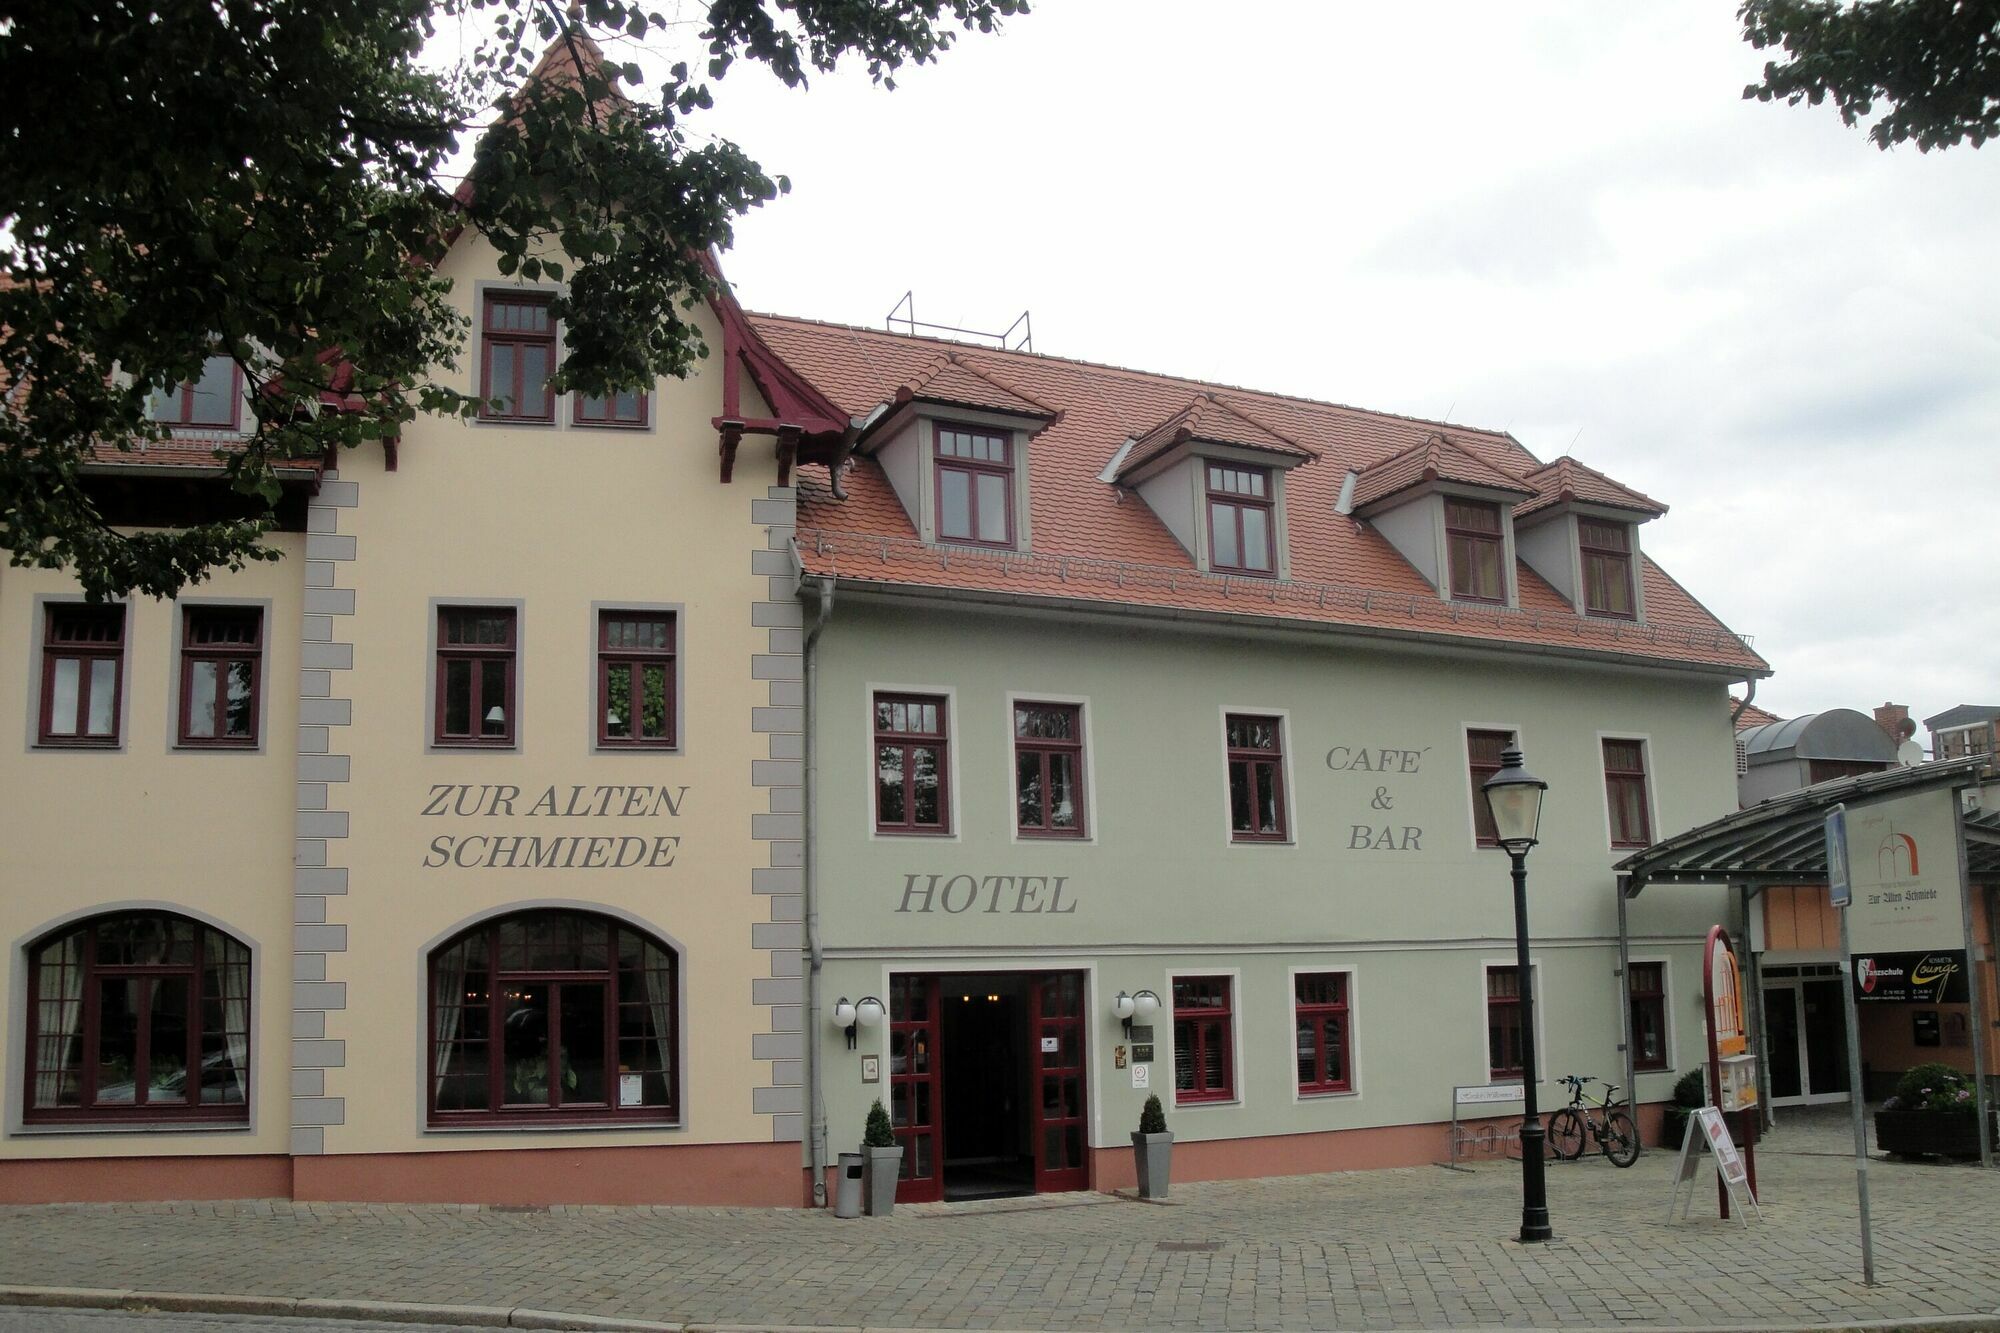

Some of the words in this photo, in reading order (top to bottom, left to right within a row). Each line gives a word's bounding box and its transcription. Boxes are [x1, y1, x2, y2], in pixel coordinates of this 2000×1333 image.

[420, 784, 521, 817] ZUR
[524, 785, 691, 817] ALTEN
[1370, 786, 1394, 810] &
[421, 835, 681, 868] SCHMIEDE
[1346, 825, 1423, 851] BAR
[894, 874, 1078, 914] HOTEL
[1865, 967, 1904, 976] Tanzschule
